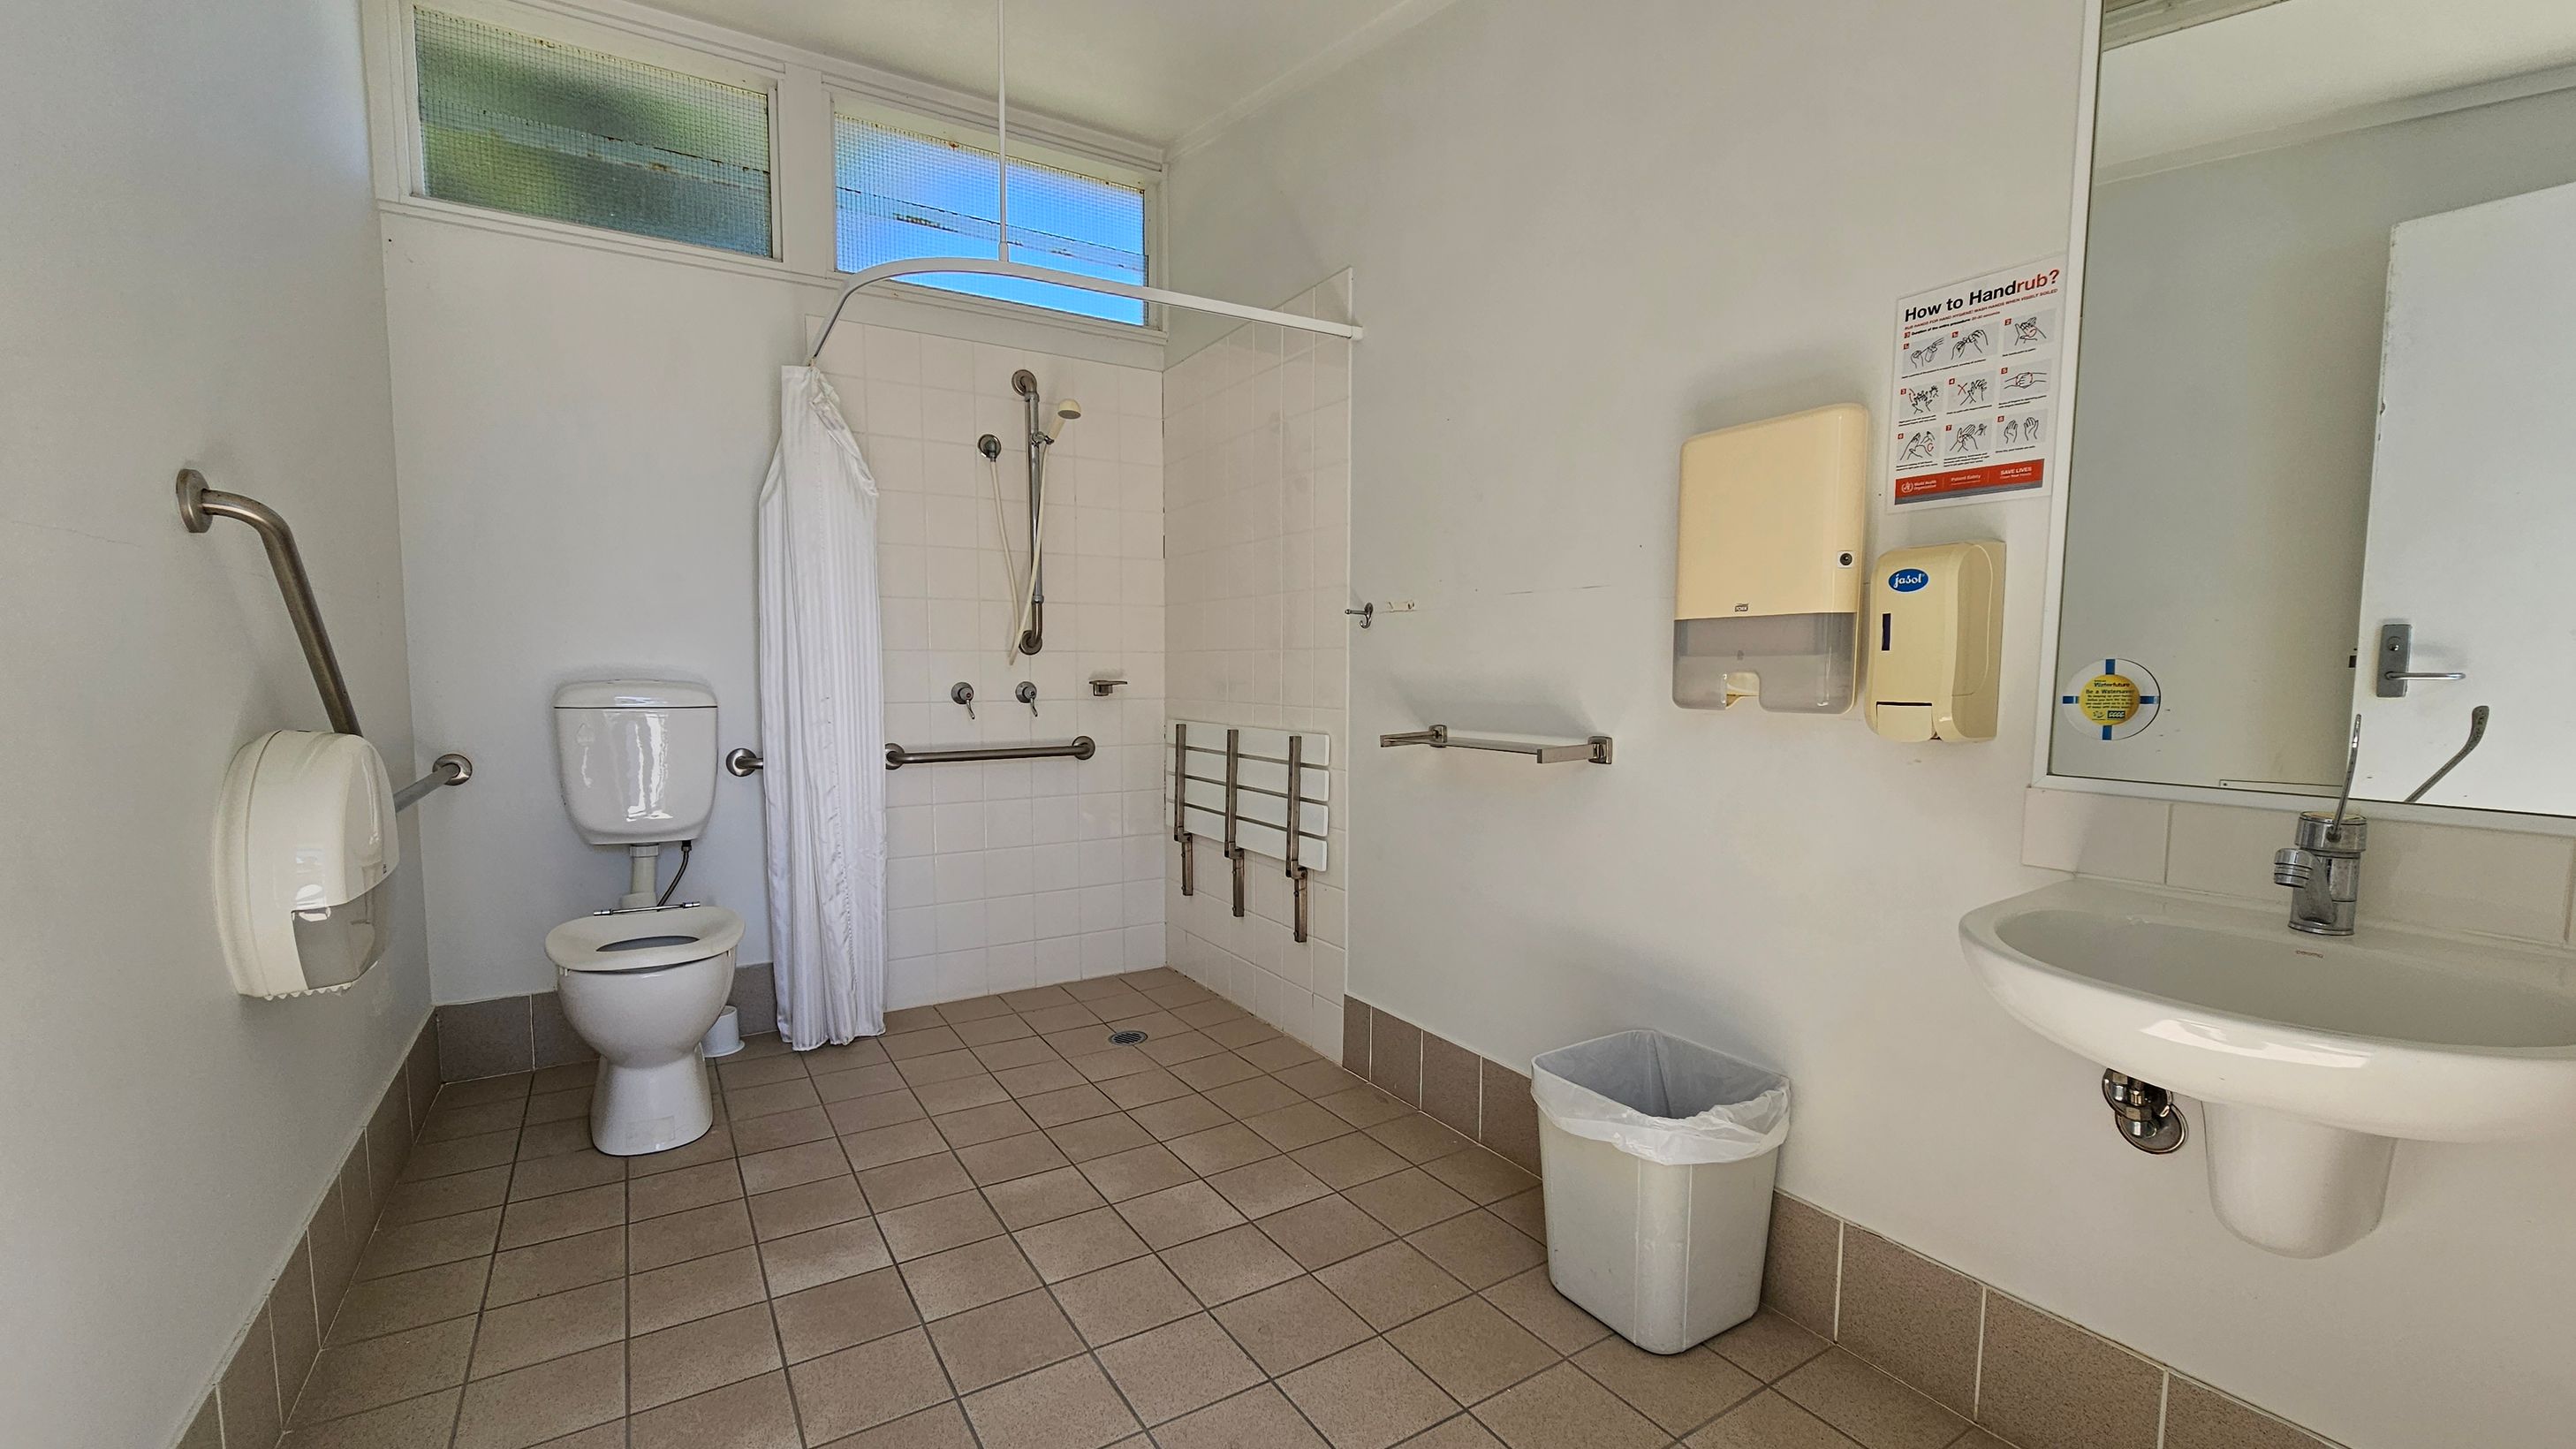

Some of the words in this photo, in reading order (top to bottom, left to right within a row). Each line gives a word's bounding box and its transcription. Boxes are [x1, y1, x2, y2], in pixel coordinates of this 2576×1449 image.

[1905, 303, 1942, 322] How
[1946, 298, 1963, 311] to
[1969, 269, 2059, 306] Handrub?
[1893, 573, 1922, 588] jasol
